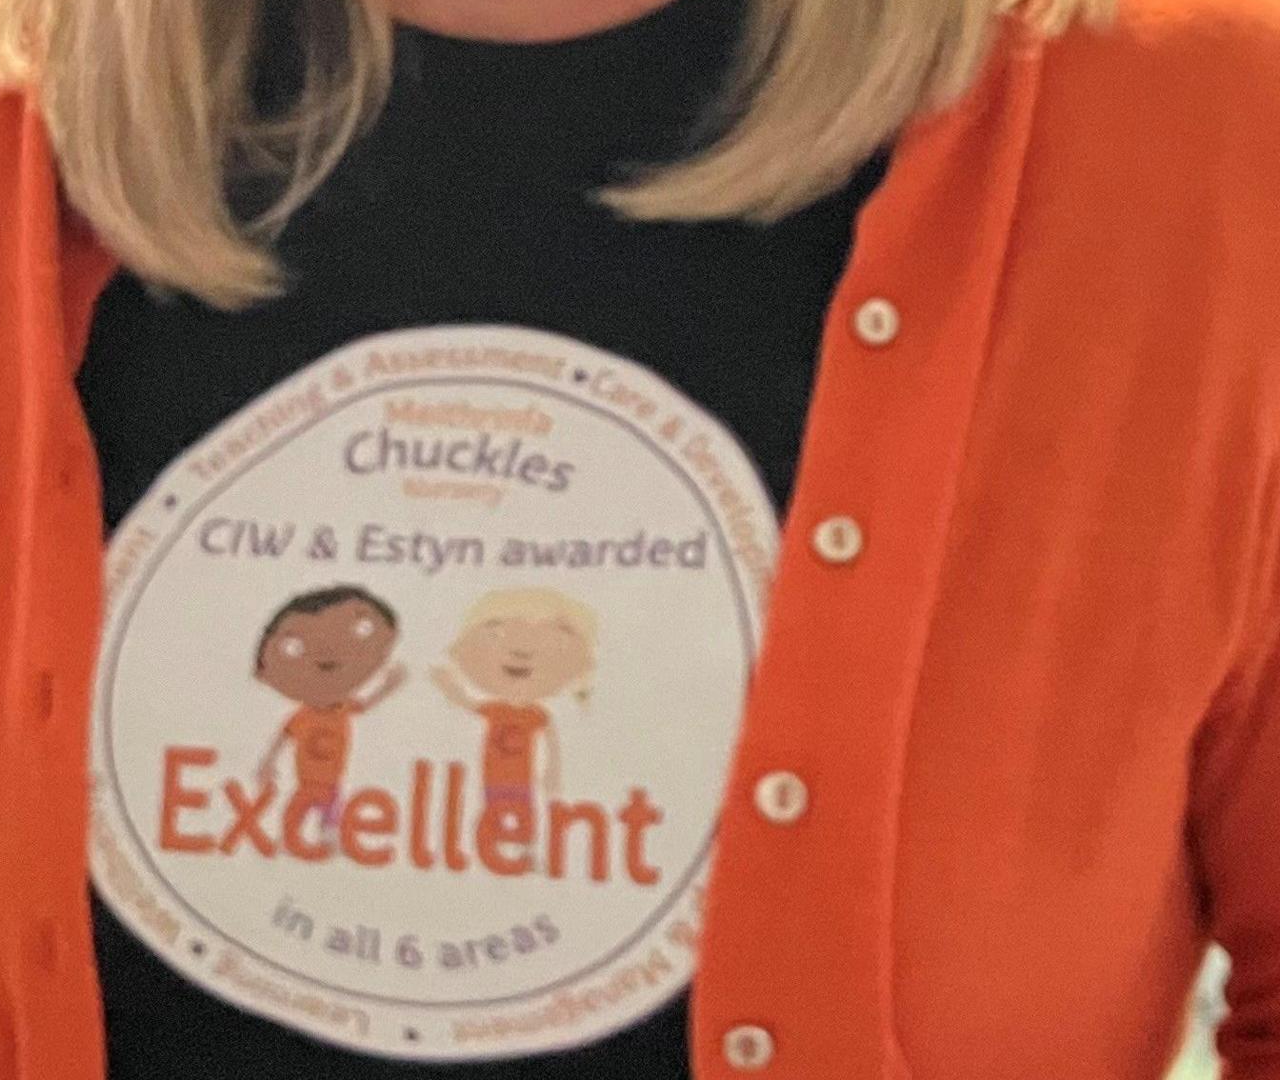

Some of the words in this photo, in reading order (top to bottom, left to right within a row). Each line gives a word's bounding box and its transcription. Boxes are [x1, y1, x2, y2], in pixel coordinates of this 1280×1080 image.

[589, 369, 657, 417] Care
[343, 425, 576, 493] Chuckles
[199, 518, 294, 559] CIW
[306, 524, 338, 560] &
[356, 523, 484, 575] Estyn
[500, 527, 707, 570] awarded
[158, 747, 664, 887] Excellent
[272, 896, 315, 941] in
[326, 924, 381, 964] all
[395, 934, 423, 970] 6
[438, 913, 561, 970] areas
